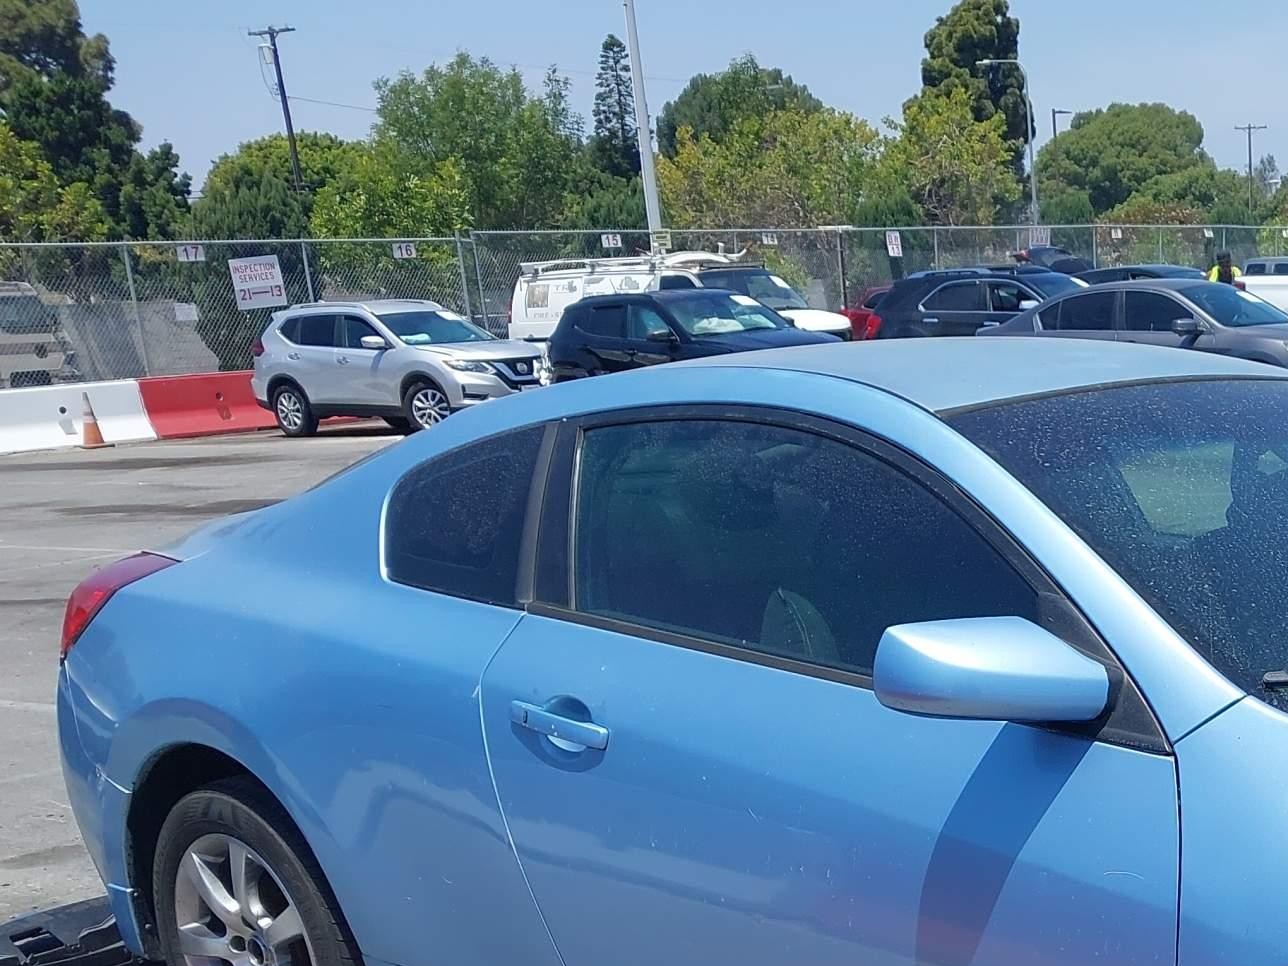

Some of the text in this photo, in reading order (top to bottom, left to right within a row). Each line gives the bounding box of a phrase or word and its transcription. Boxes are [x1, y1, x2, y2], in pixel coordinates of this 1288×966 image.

[606, 235, 619, 246] 15
[183, 246, 199, 260] 17
[398, 244, 413, 257] 16
[232, 262, 276, 274] INSPECTION
[239, 271, 275, 284] SERVICES
